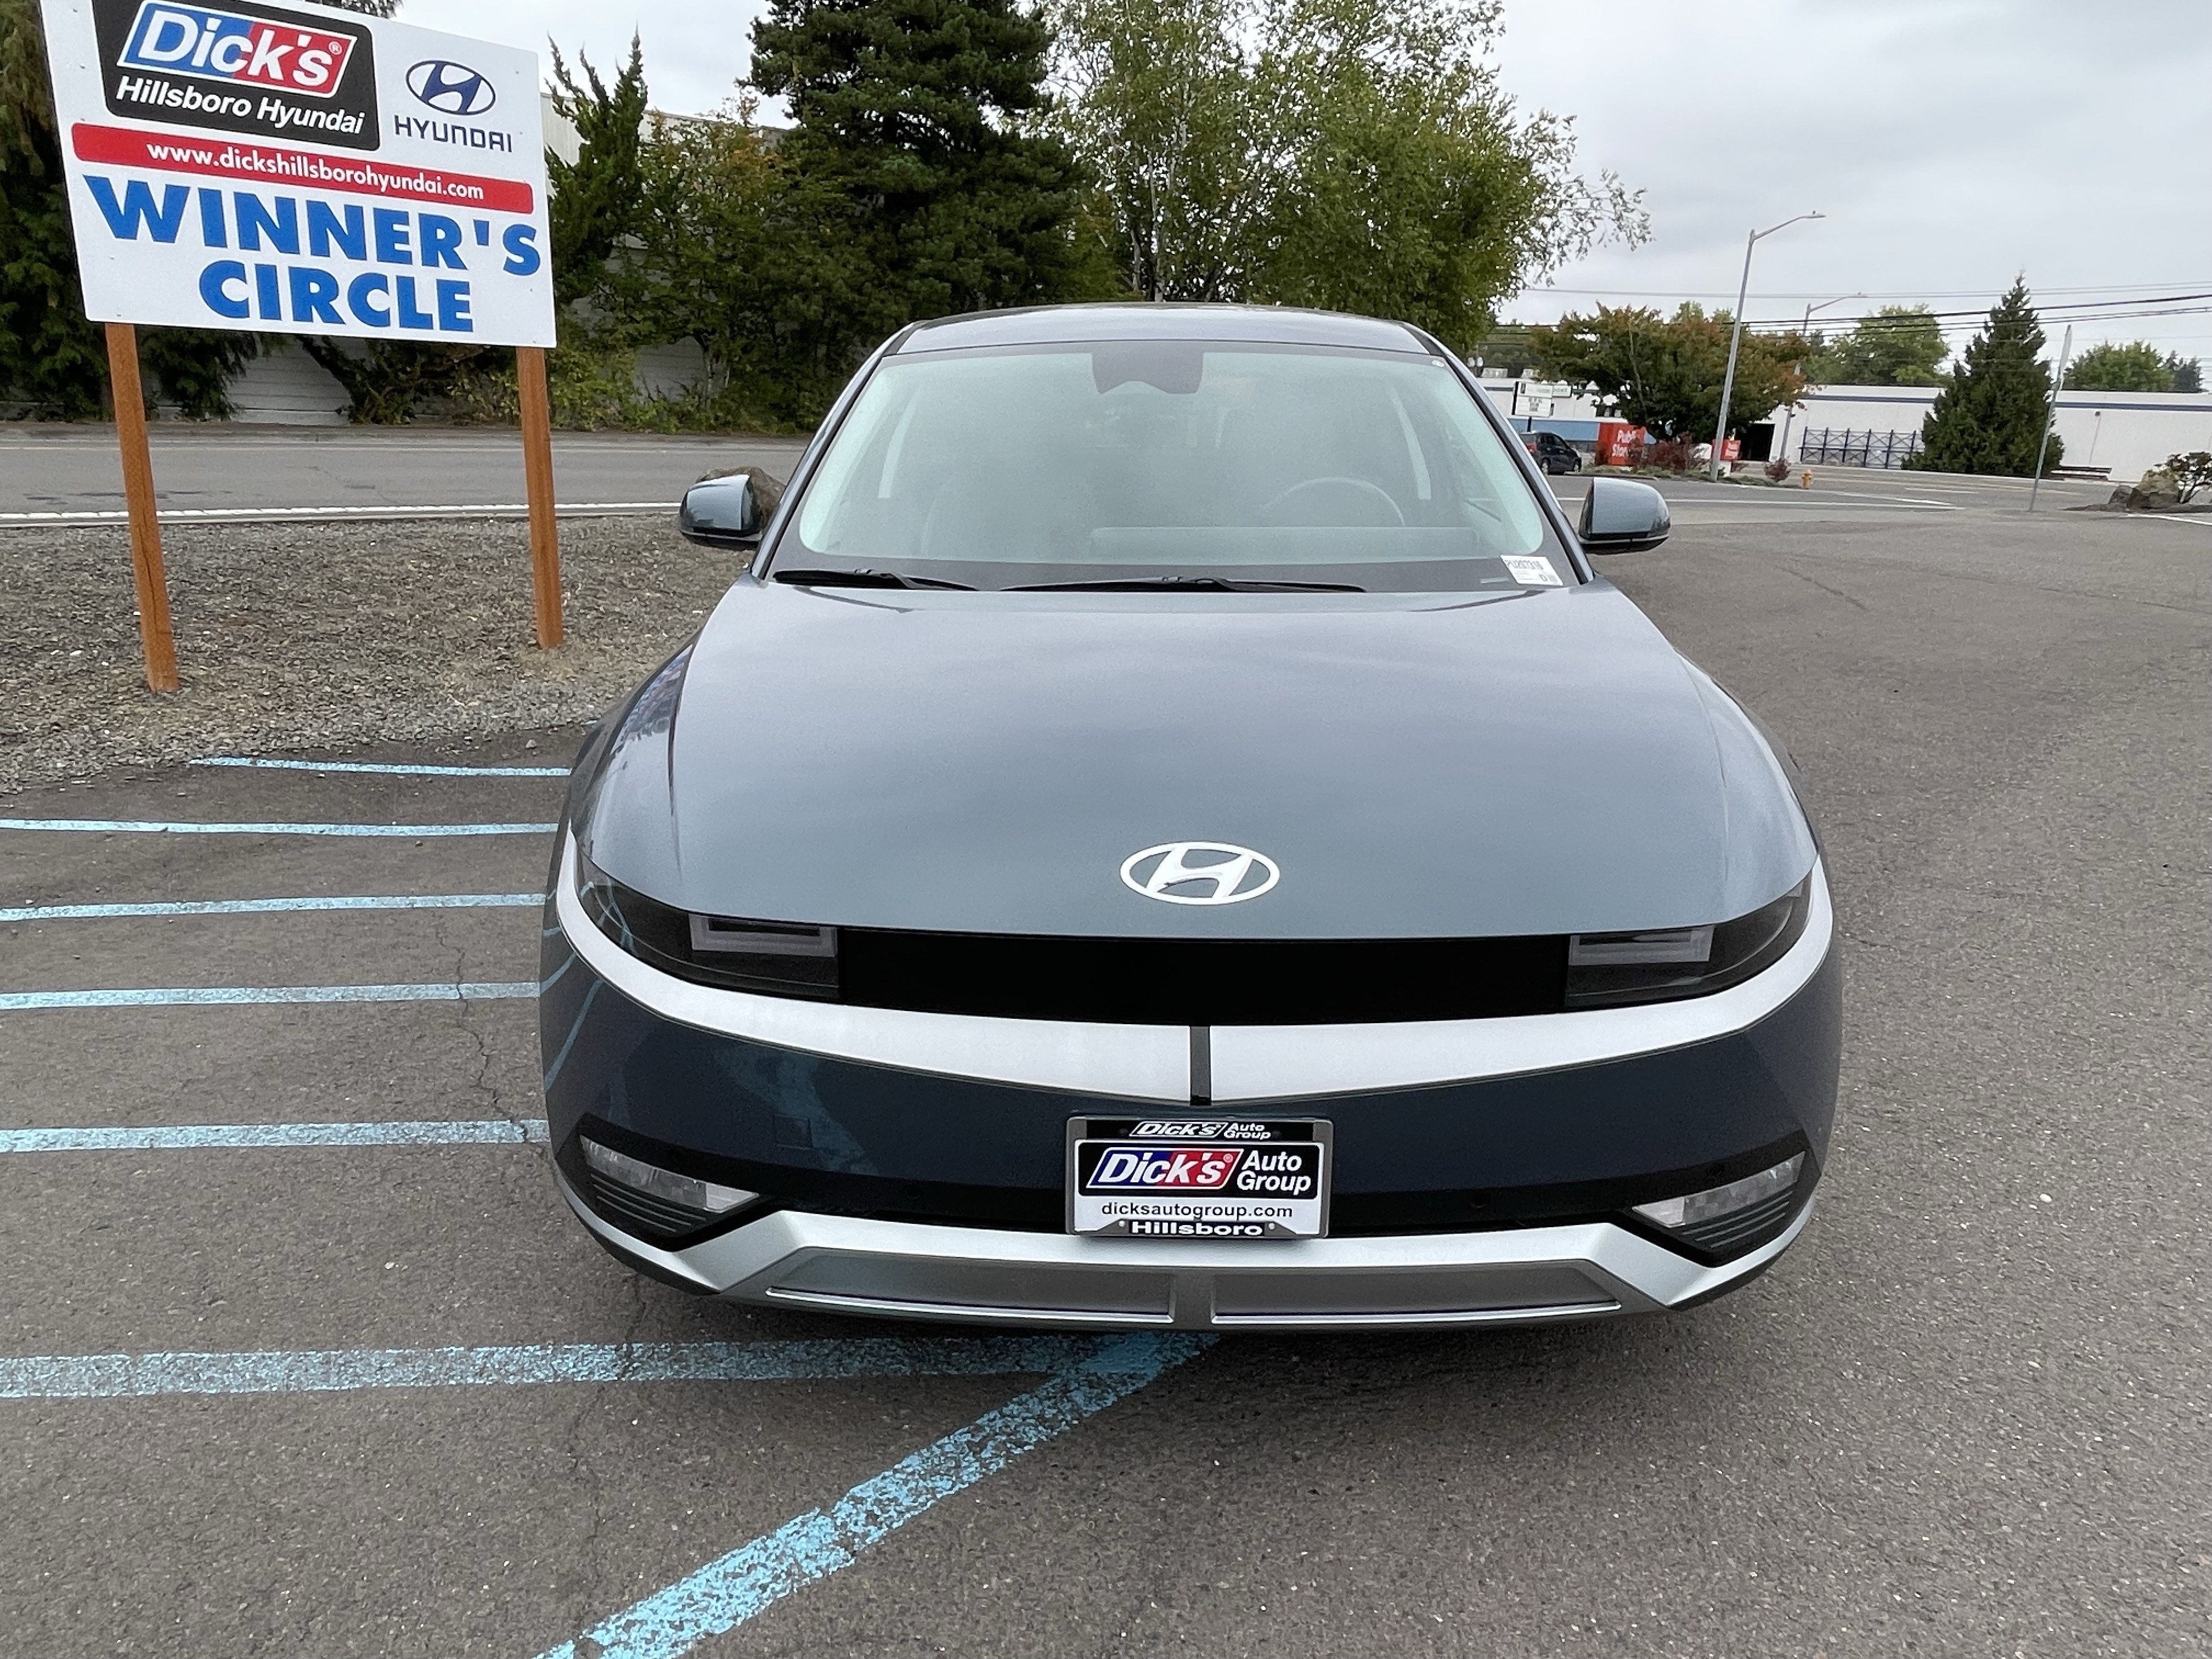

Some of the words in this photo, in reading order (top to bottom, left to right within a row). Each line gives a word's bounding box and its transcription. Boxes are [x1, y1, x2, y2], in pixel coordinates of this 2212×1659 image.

[115, 76, 252, 117] Hillsboro
[257, 97, 366, 134] Hyundai
[394, 114, 512, 153] HYUNDAI
[146, 141, 485, 201] www.dickshillsborohyundai.com
[83, 174, 541, 276] WINNER'S
[199, 260, 473, 332] CIRCLE
[1223, 1131, 1272, 1140] Group
[1227, 1122, 1265, 1131] Auto
[1242, 1150, 1302, 1171] Auto
[1237, 1171, 1312, 1195] Group
[1101, 1202, 1294, 1221] dicksautogroup.com
[1131, 1221, 1264, 1236] Hillsboro
